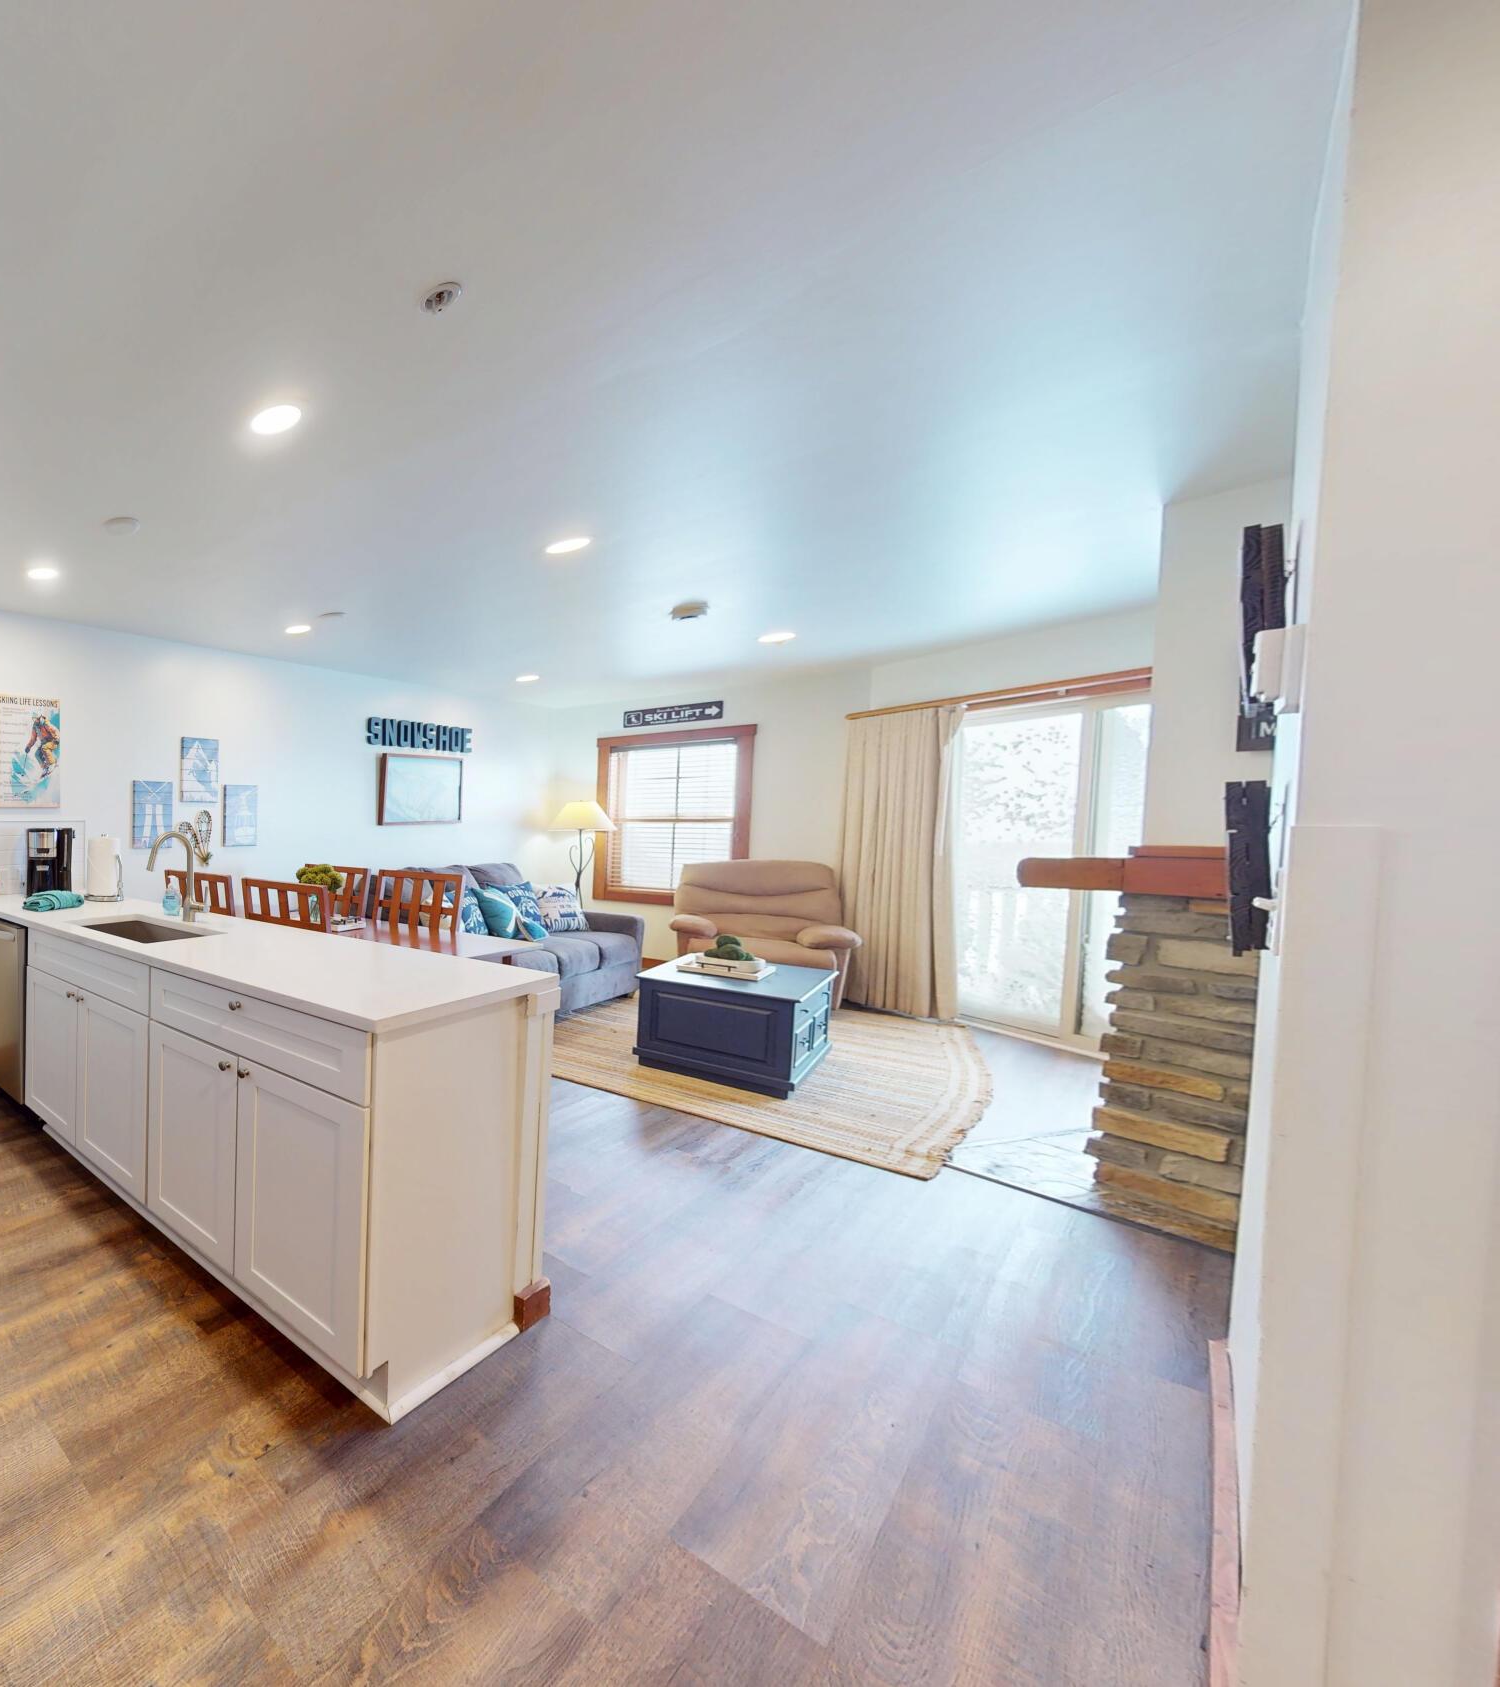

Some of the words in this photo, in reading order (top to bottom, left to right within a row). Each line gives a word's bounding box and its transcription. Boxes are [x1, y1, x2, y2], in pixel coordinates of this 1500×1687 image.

[19, 697, 31, 706] LIFE
[32, 699, 58, 708] LESSONS
[644, 712, 667, 722] SKI
[671, 708, 703, 719] LIFT
[366, 716, 473, 753] SNOWSHOE
